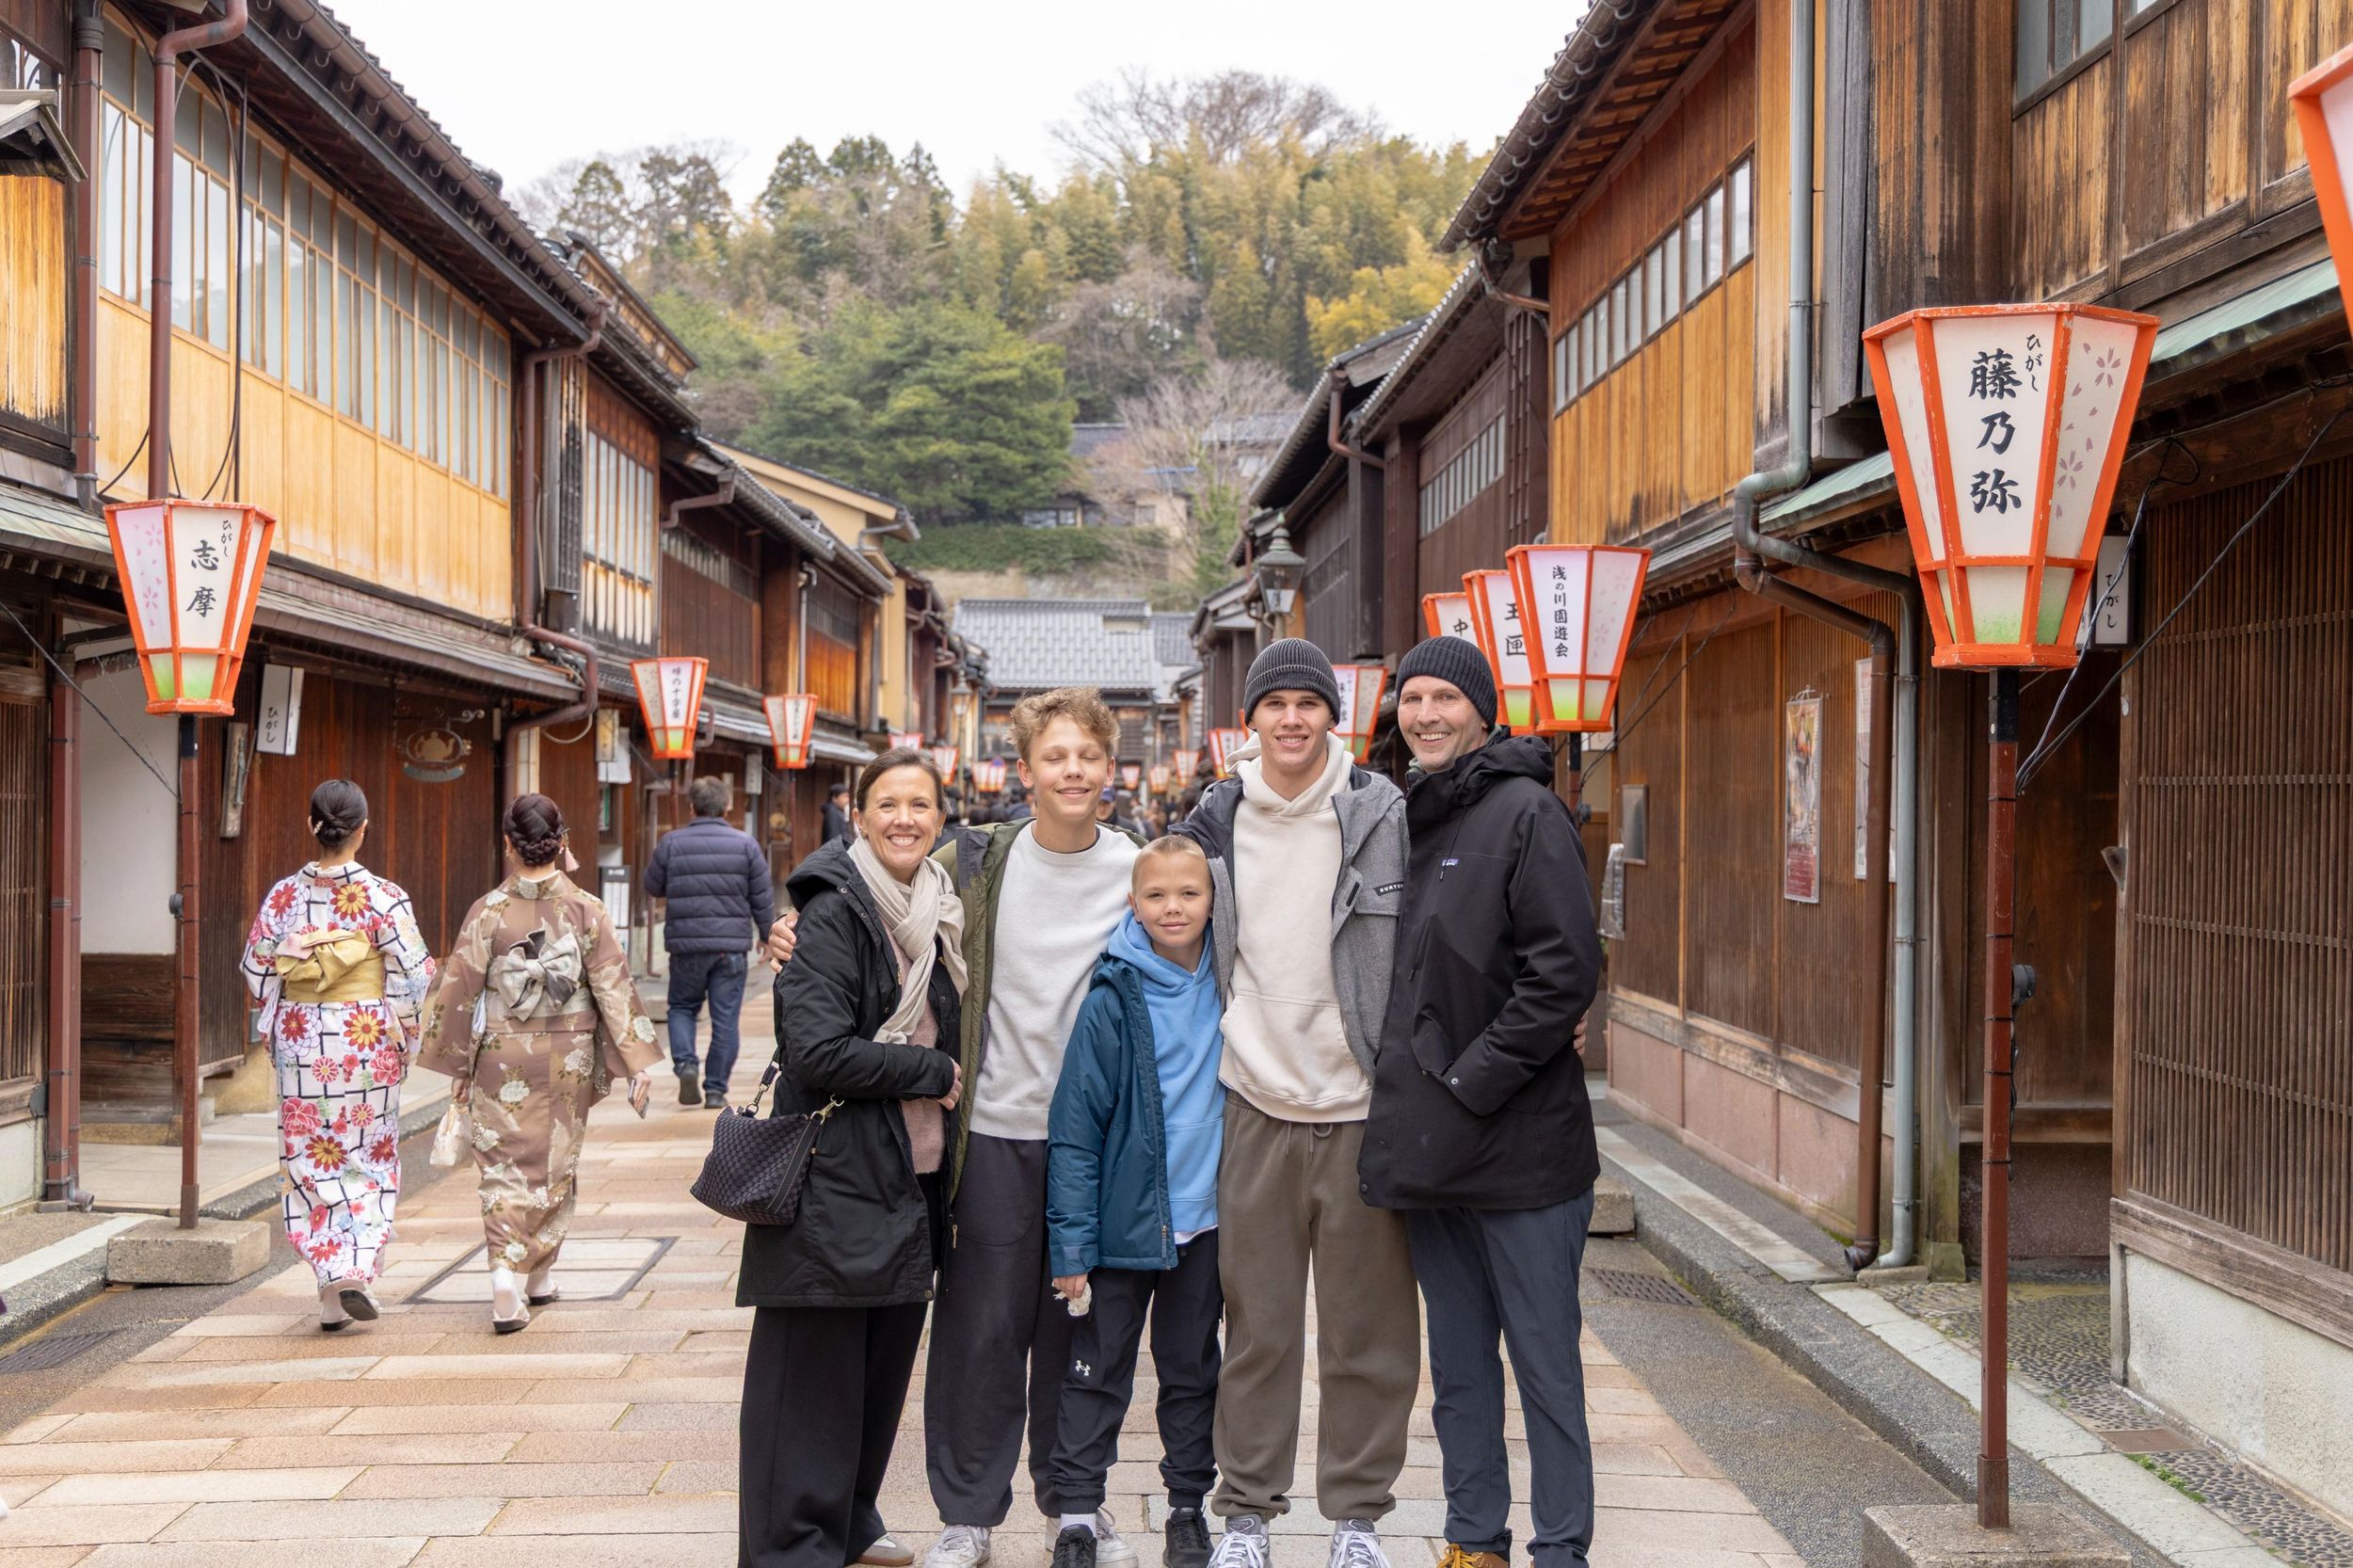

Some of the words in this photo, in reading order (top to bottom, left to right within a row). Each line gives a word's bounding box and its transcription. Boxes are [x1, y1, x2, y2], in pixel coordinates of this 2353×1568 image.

[2025, 334, 2042, 392] ひがし
[1968, 347, 2024, 515] 藤乃弥
[221, 519, 233, 557] ひがし
[186, 539, 219, 617] 志摩
[1552, 564, 1569, 658] 浅の川園遊会
[265, 707, 279, 744] ひがし
